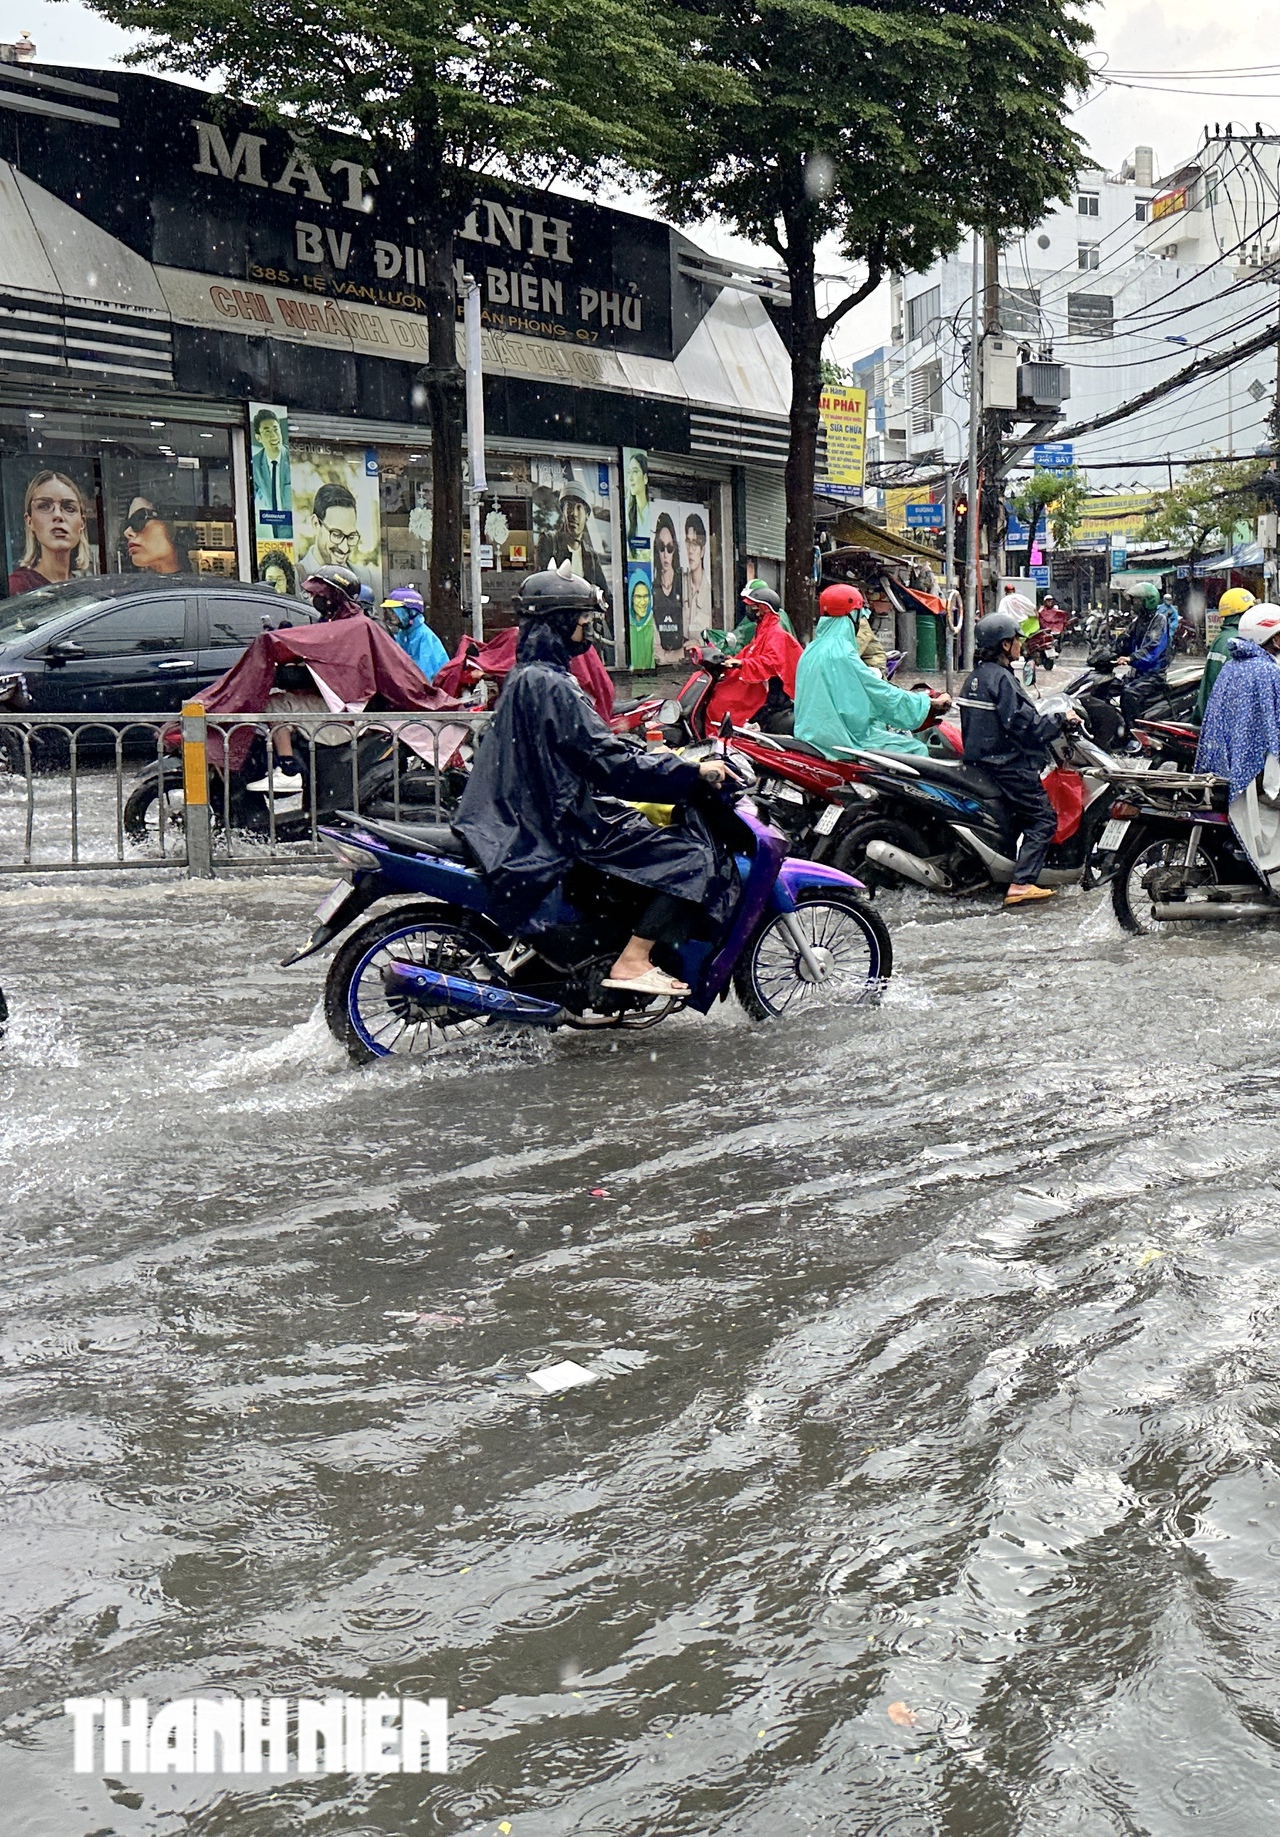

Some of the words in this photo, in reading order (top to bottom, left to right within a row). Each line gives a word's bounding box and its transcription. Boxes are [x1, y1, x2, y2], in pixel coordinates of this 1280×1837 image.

[252, 265, 290, 282] 385
[332, 279, 374, 300] VĂN
[508, 315, 567, 336] PHONG
[575, 328, 599, 342] Q7
[295, 220, 352, 270] BV
[486, 262, 564, 315] BIÊN
[579, 282, 642, 331] PHỦ
[209, 285, 275, 324] CHI
[276, 297, 390, 344] NHÁNH
[526, 343, 574, 376] TẠI
[833, 397, 861, 413] PHÁT
[289, 443, 331, 455] ssentials
